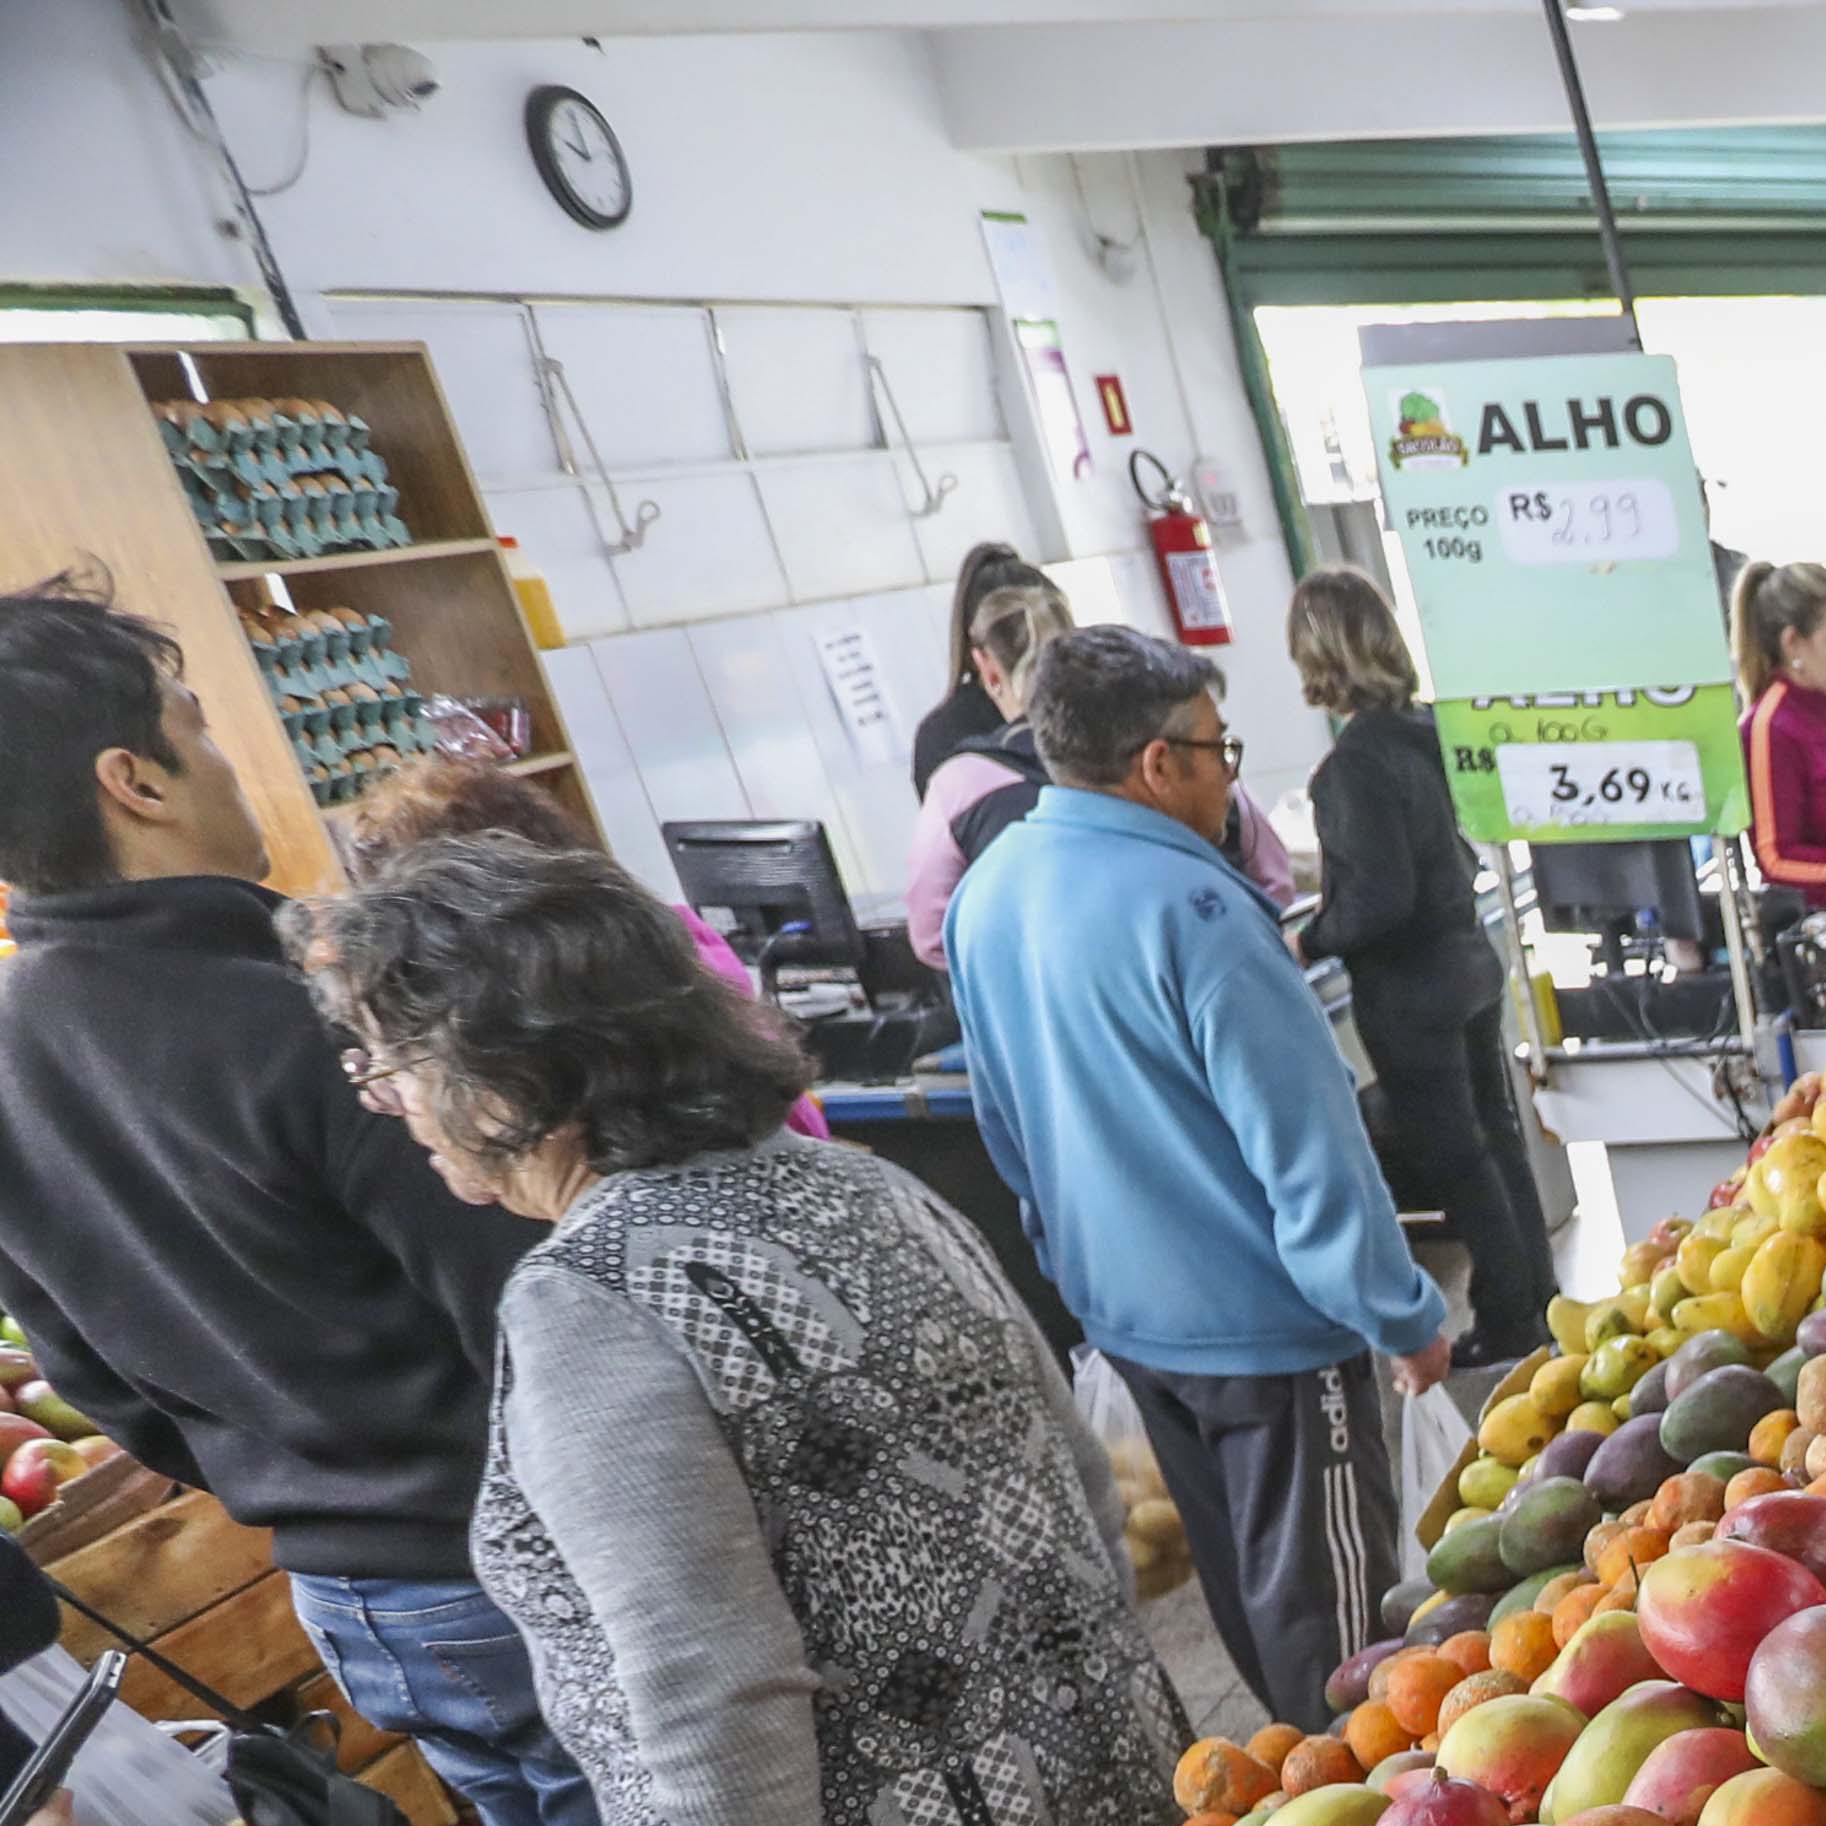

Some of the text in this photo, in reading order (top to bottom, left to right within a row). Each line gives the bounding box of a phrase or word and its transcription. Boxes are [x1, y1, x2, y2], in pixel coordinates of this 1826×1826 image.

[1478, 394, 1673, 455] ALHO
[1406, 504, 1489, 531] PREÇO
[1509, 491, 1552, 522] R$
[1422, 537, 1483, 563] 100g
[1454, 746, 1498, 775] R$
[1550, 763, 1652, 807] 3,69
[1318, 1366, 1349, 1452] adid
